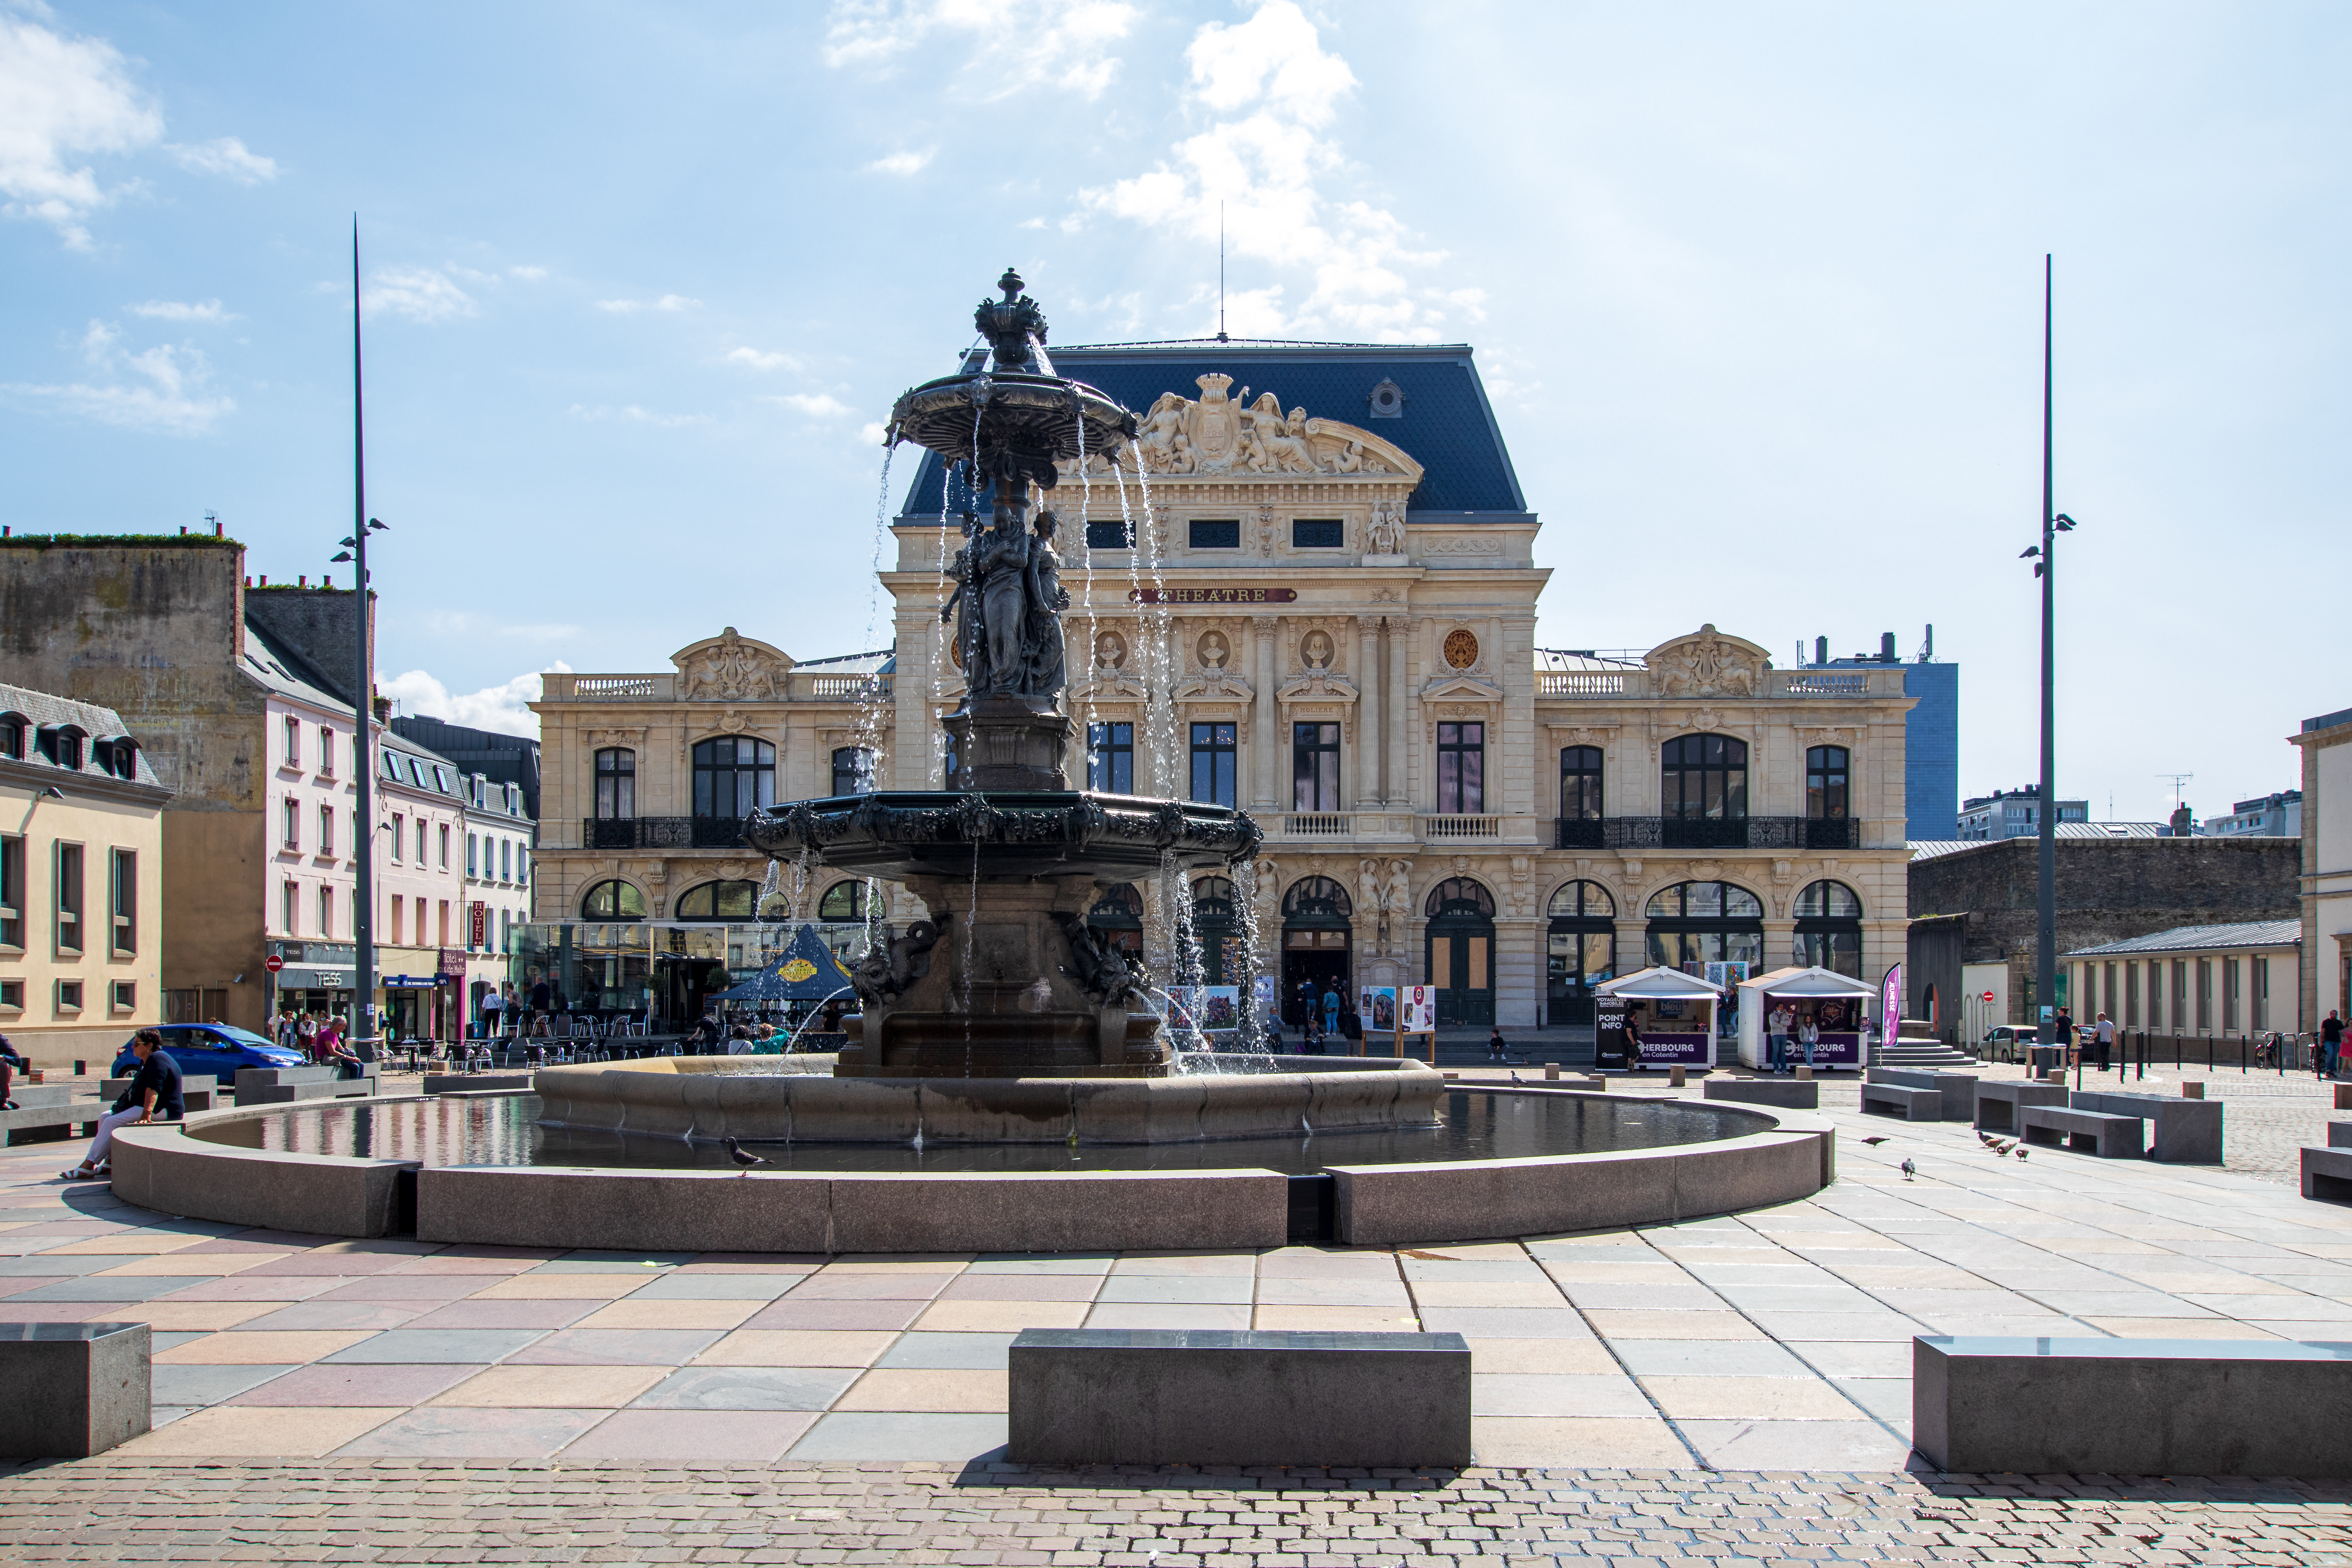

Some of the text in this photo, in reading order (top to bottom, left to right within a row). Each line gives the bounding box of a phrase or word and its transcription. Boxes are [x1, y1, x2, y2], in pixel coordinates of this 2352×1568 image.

[1162, 590, 1265, 601] THEATRE
[474, 902, 483, 939] HOTEL
[443, 953, 457, 963] Hôtel
[447, 965, 453, 973] de
[454, 965, 465, 973] Malte
[315, 971, 343, 987] TESS
[1661, 1002, 1681, 1011] bleu
